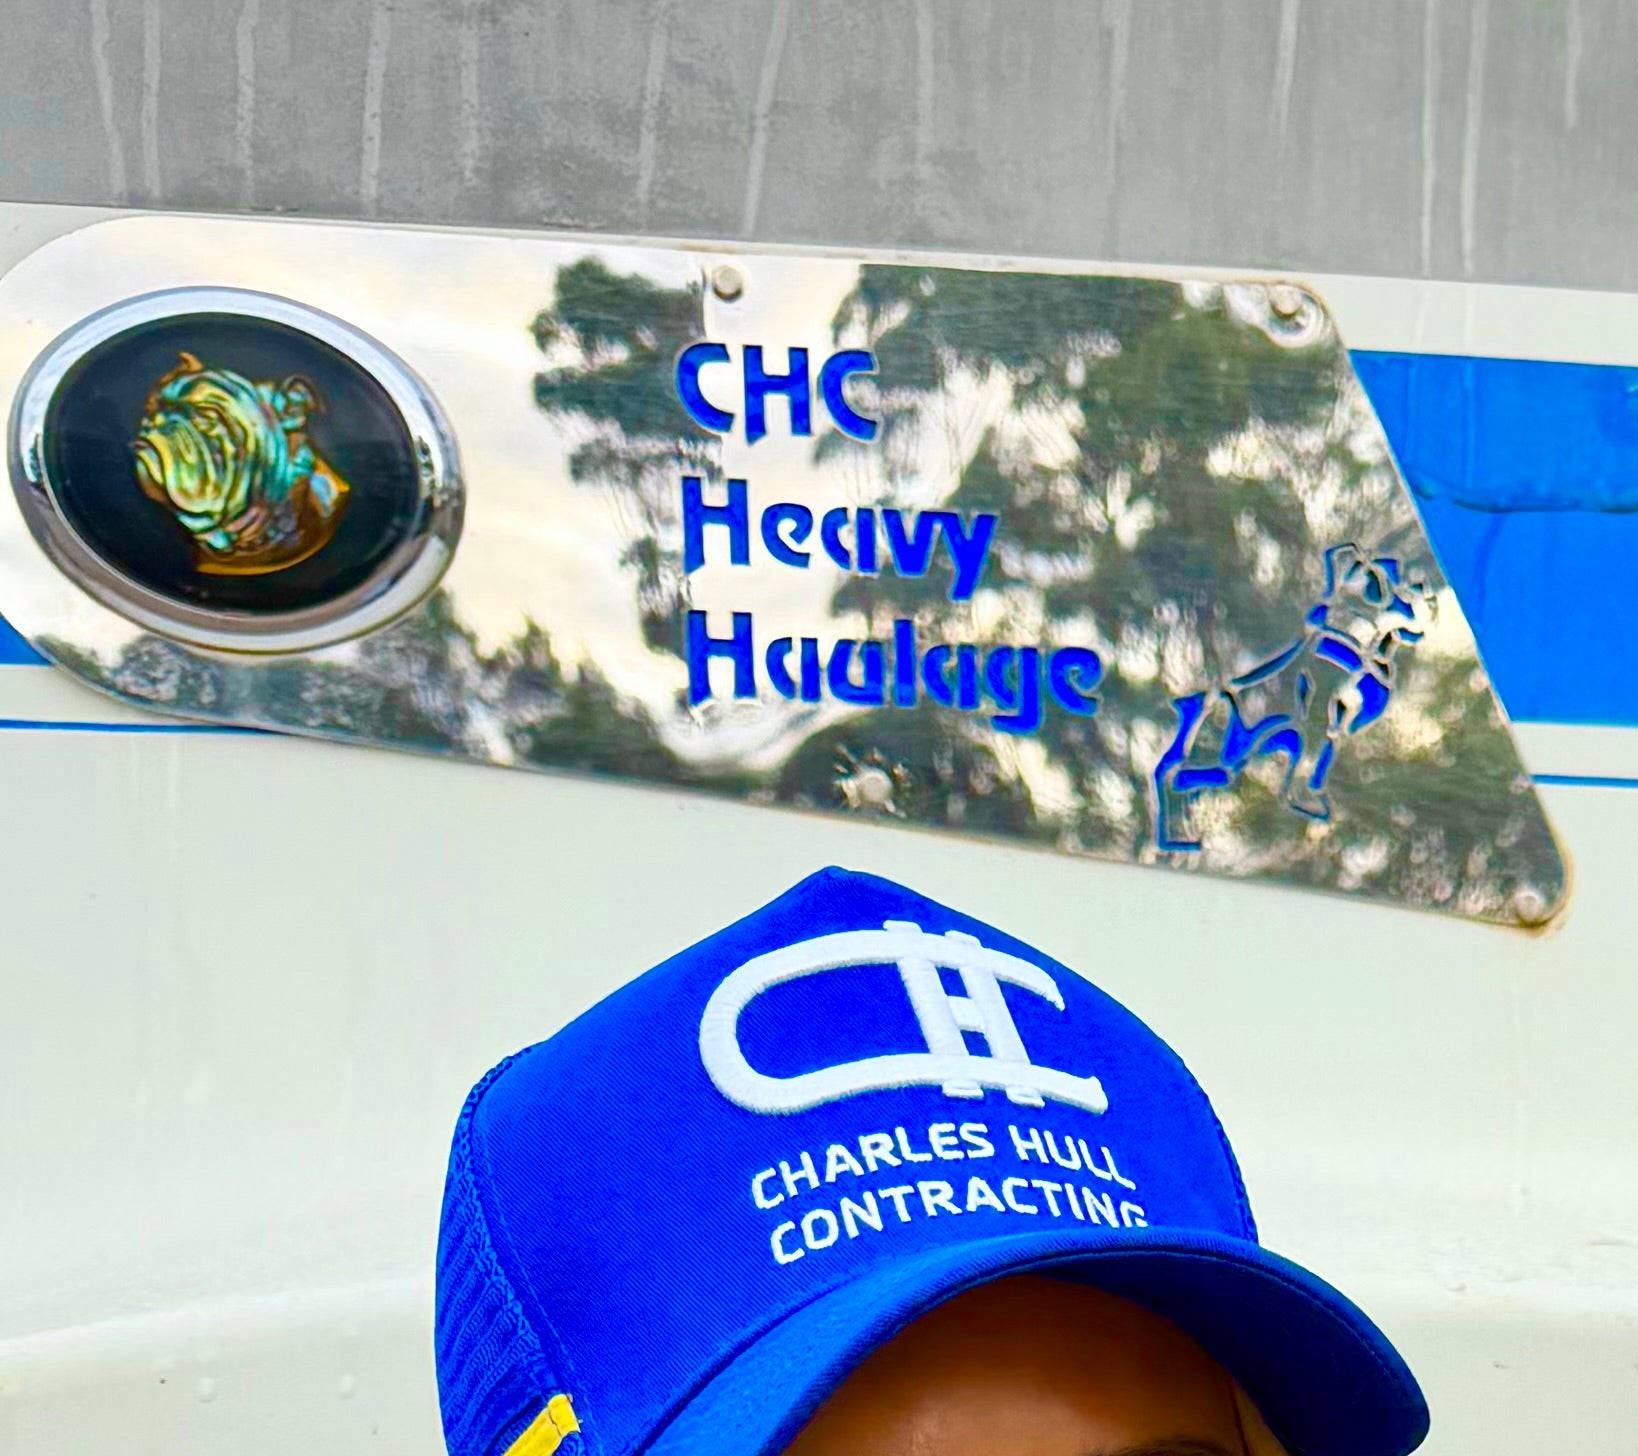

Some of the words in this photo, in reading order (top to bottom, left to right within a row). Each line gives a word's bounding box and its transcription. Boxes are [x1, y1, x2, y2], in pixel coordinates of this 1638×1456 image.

[675, 342, 880, 446] CHC
[681, 475, 998, 601] Heavy
[686, 609, 1103, 735] Haulage
[751, 1122, 996, 1211] CHARLES
[1008, 1124, 1136, 1190] HULL
